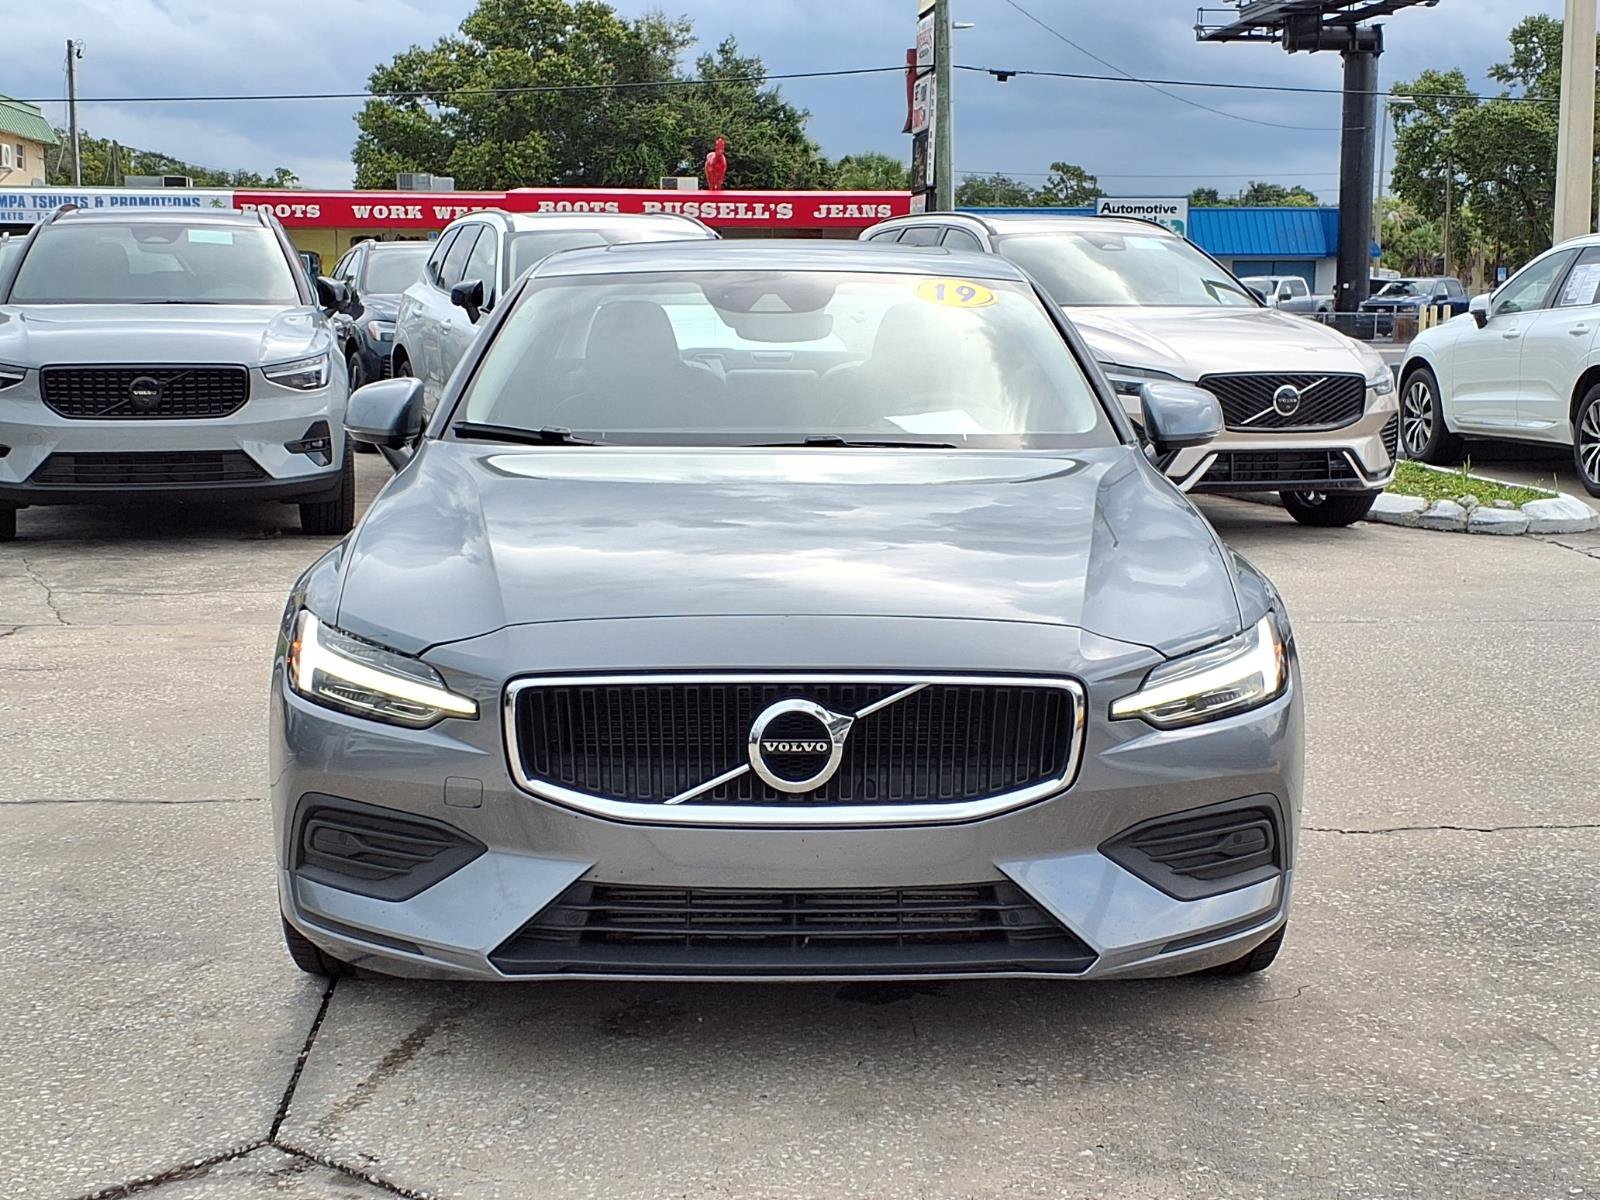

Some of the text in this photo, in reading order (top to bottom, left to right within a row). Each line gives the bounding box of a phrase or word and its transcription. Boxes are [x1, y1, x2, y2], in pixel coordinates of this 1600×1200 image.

[32, 195, 89, 208] TSHIRTS
[94, 196, 104, 208] &
[110, 196, 201, 207] PROMOTIONS
[1100, 202, 1178, 214] Automotive
[351, 205, 423, 219] WORK
[432, 206, 500, 219] WE
[642, 202, 793, 219] RUSSELL'S
[813, 204, 892, 218] JEANS
[762, 742, 828, 752] VOLVO
